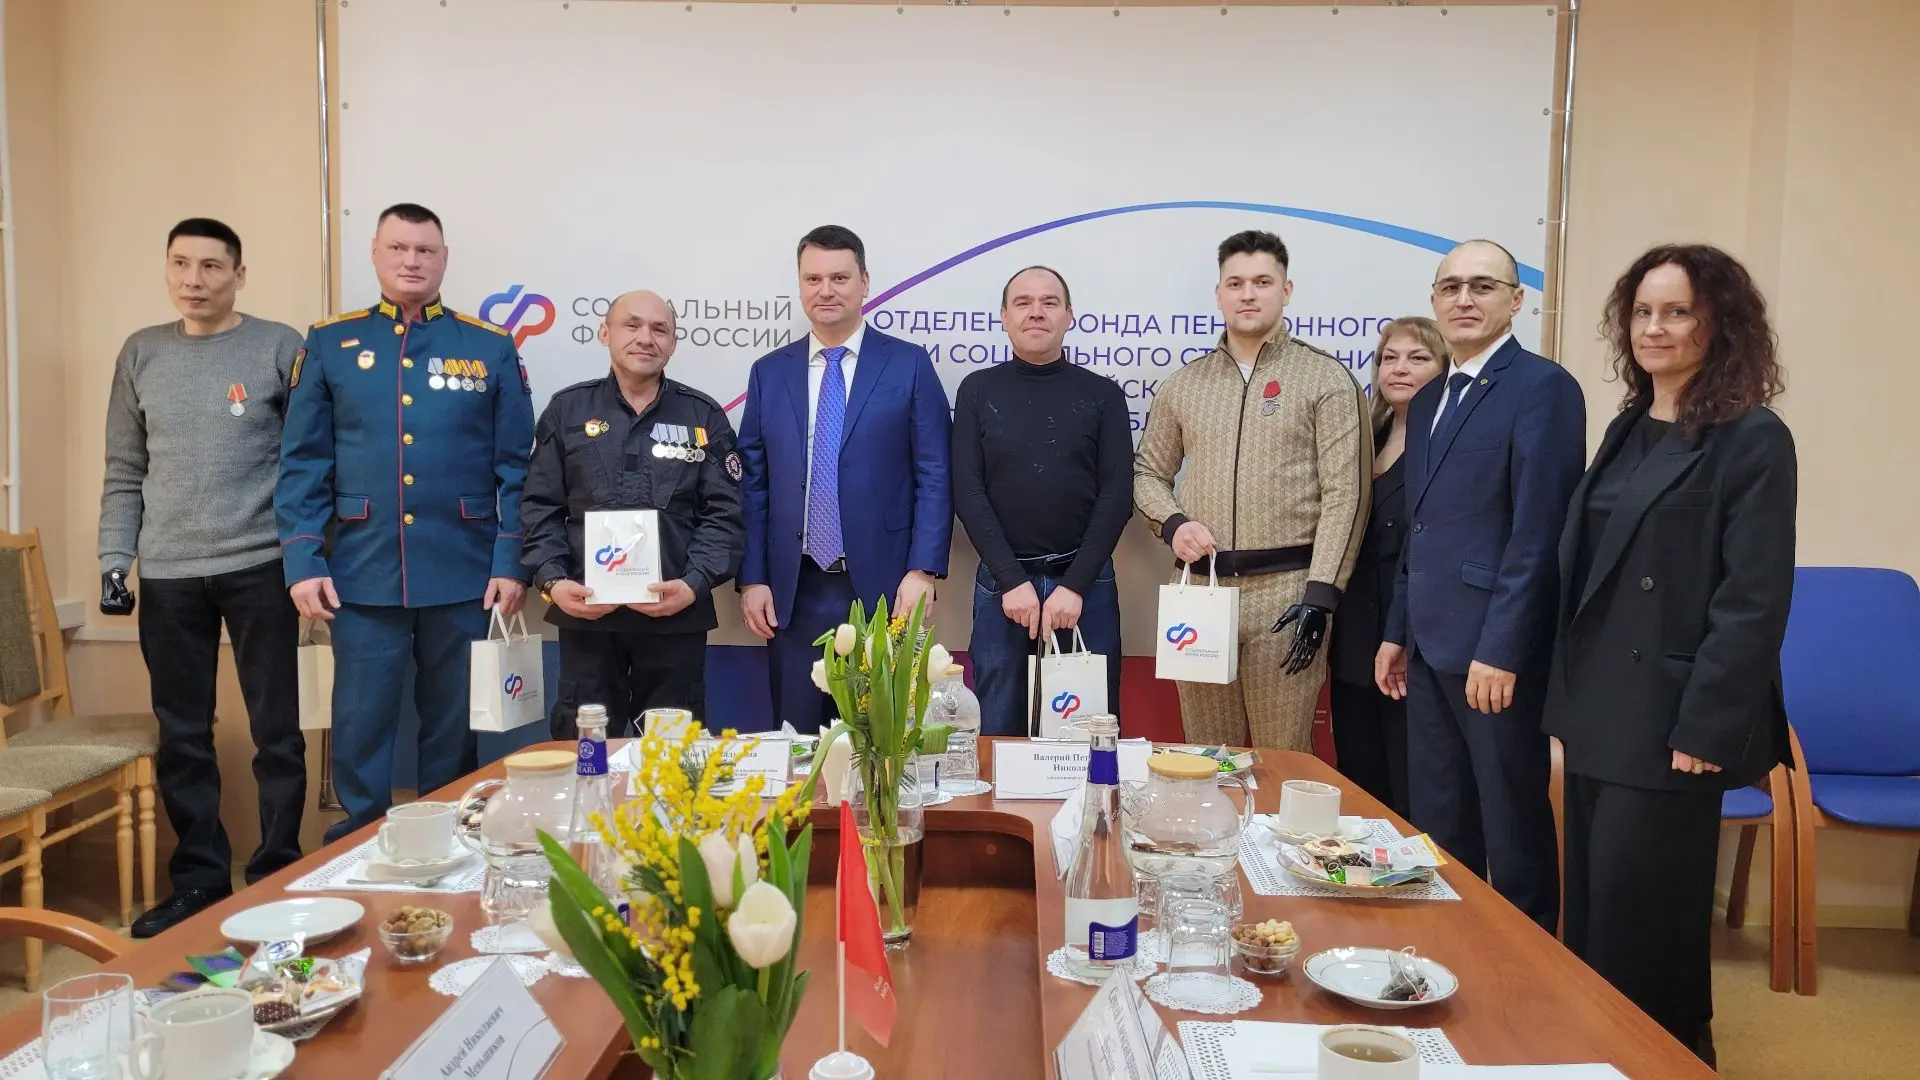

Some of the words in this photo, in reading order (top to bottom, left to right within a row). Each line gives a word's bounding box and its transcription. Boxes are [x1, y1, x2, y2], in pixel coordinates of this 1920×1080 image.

[572, 295, 791, 320] СОАЛЬНЫЙ
[873, 310, 1007, 334] ОТДЕЛЕН
[949, 344, 1171, 367] СОЦЛЬНОГО
[1033, 753, 1071, 762] Валерий
[1053, 763, 1089, 772] Никола
[439, 1044, 469, 1080] Андрей
[462, 1005, 505, 1052] Николаевич
